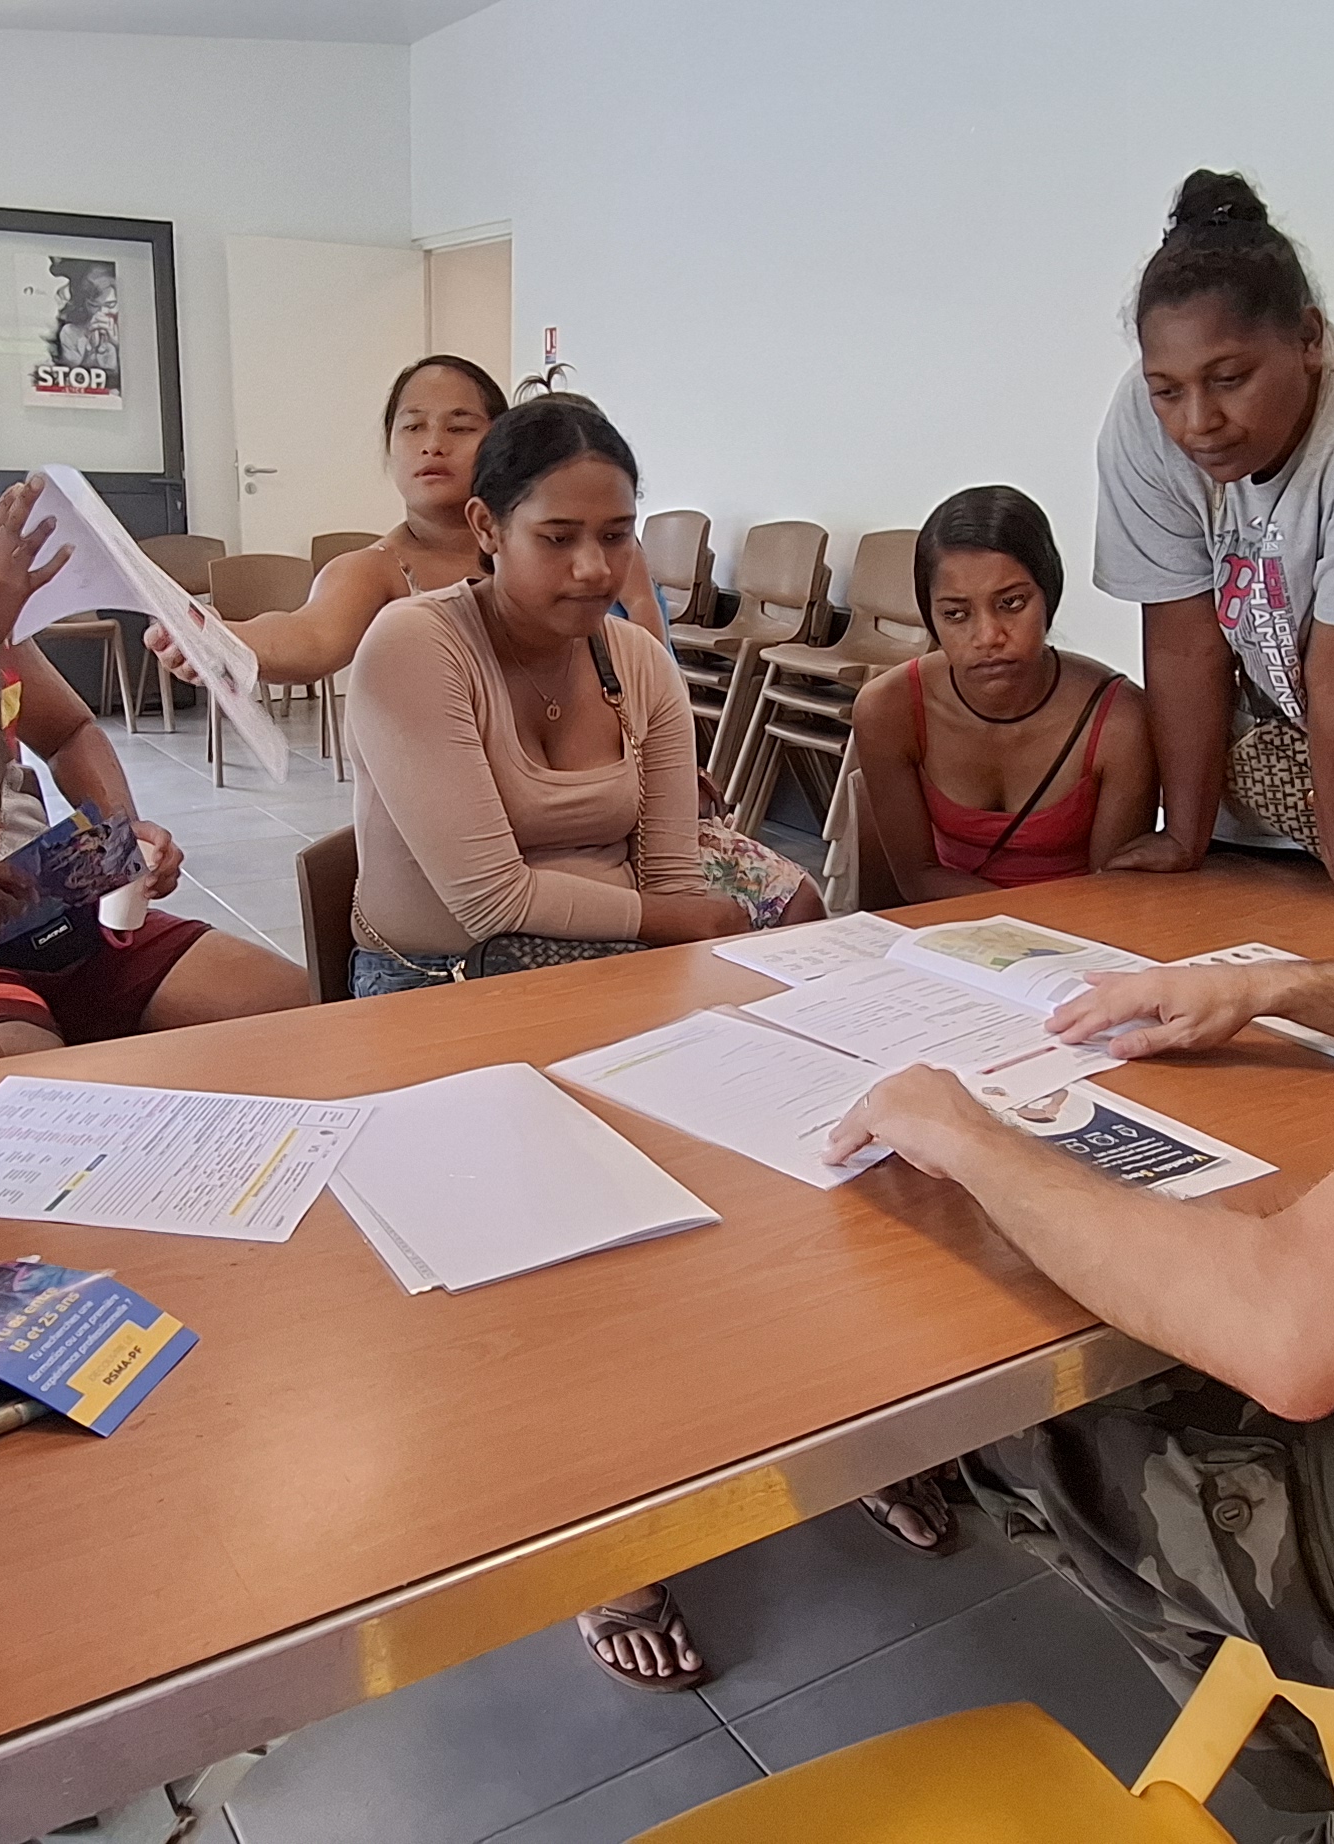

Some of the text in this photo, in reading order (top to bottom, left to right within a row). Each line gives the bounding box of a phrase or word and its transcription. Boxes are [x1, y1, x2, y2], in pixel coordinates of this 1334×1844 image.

[38, 365, 107, 389] STOP
[1271, 609, 1299, 667] WORLD
[8, 1291, 80, 1352] 18 et 25 ans
[103, 1345, 142, 1386] RSMA-PF
